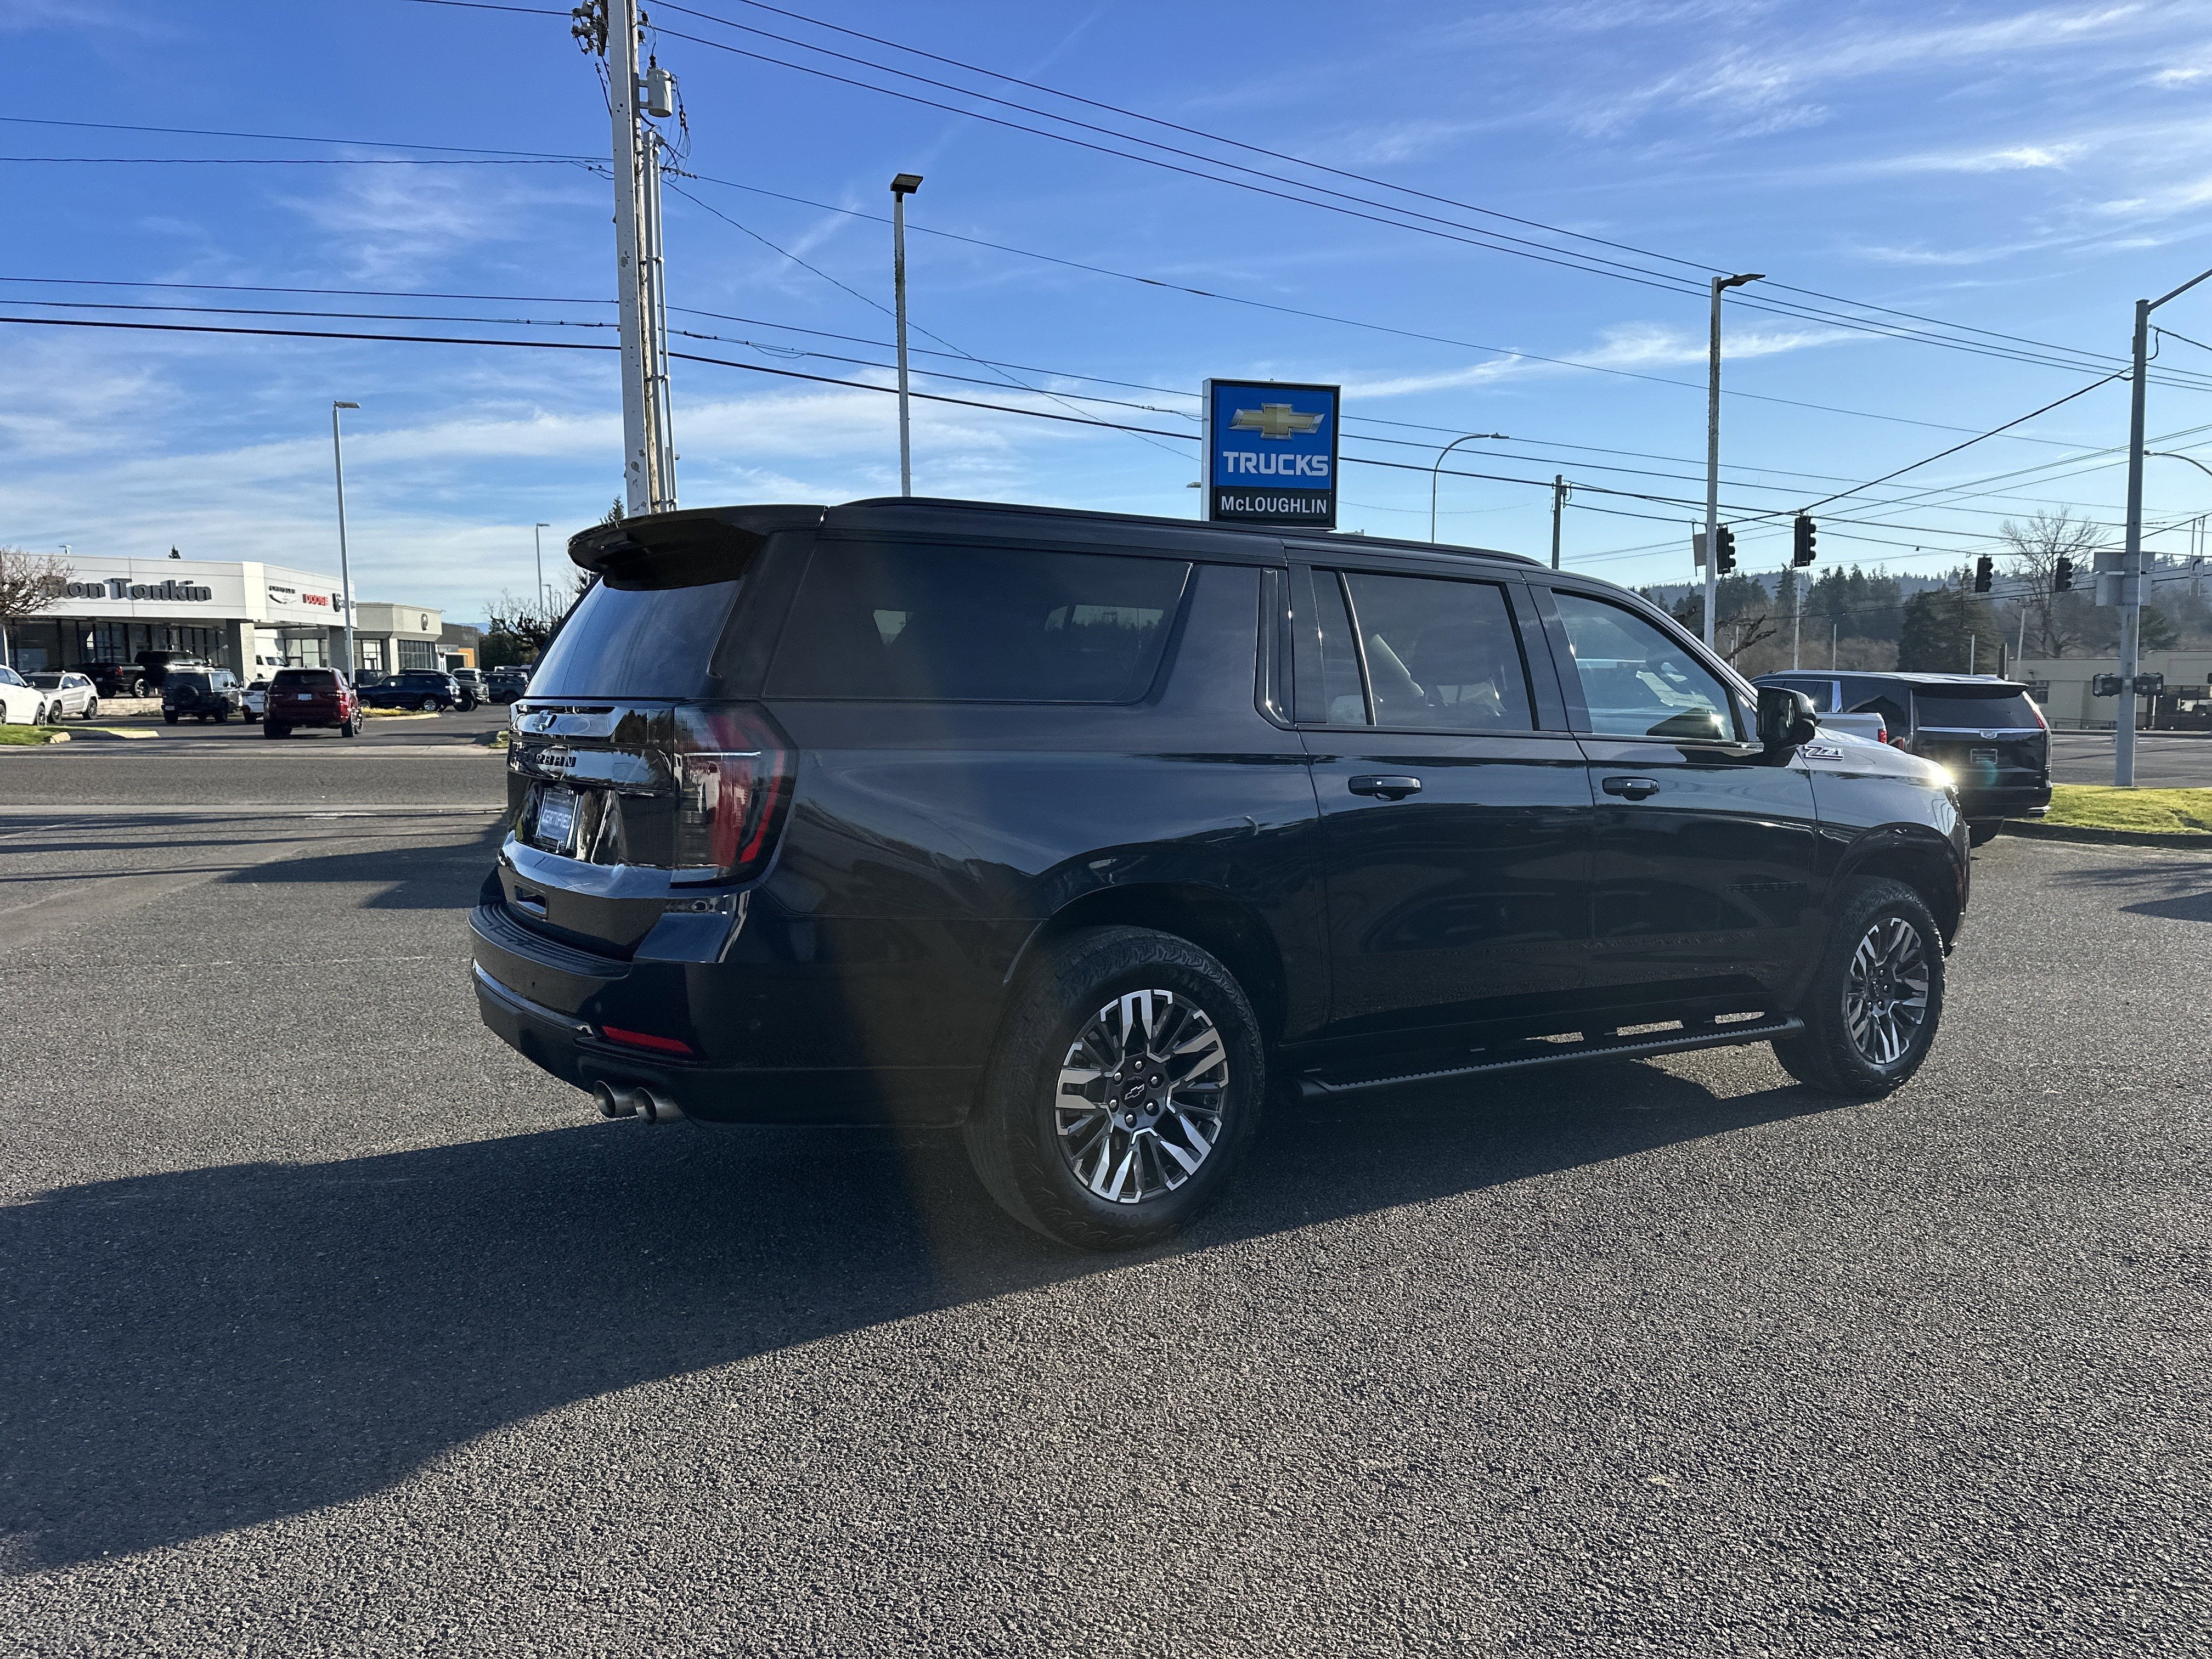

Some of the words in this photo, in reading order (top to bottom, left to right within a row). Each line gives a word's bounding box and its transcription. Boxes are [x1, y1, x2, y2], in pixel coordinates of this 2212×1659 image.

[1223, 451, 1329, 476] TRUCKS
[1221, 495, 1327, 514] McLOUGHLIN
[103, 578, 212, 602] Tonkin
[1803, 744, 1844, 761] Z71
[541, 809, 572, 830] CERTIFIED
